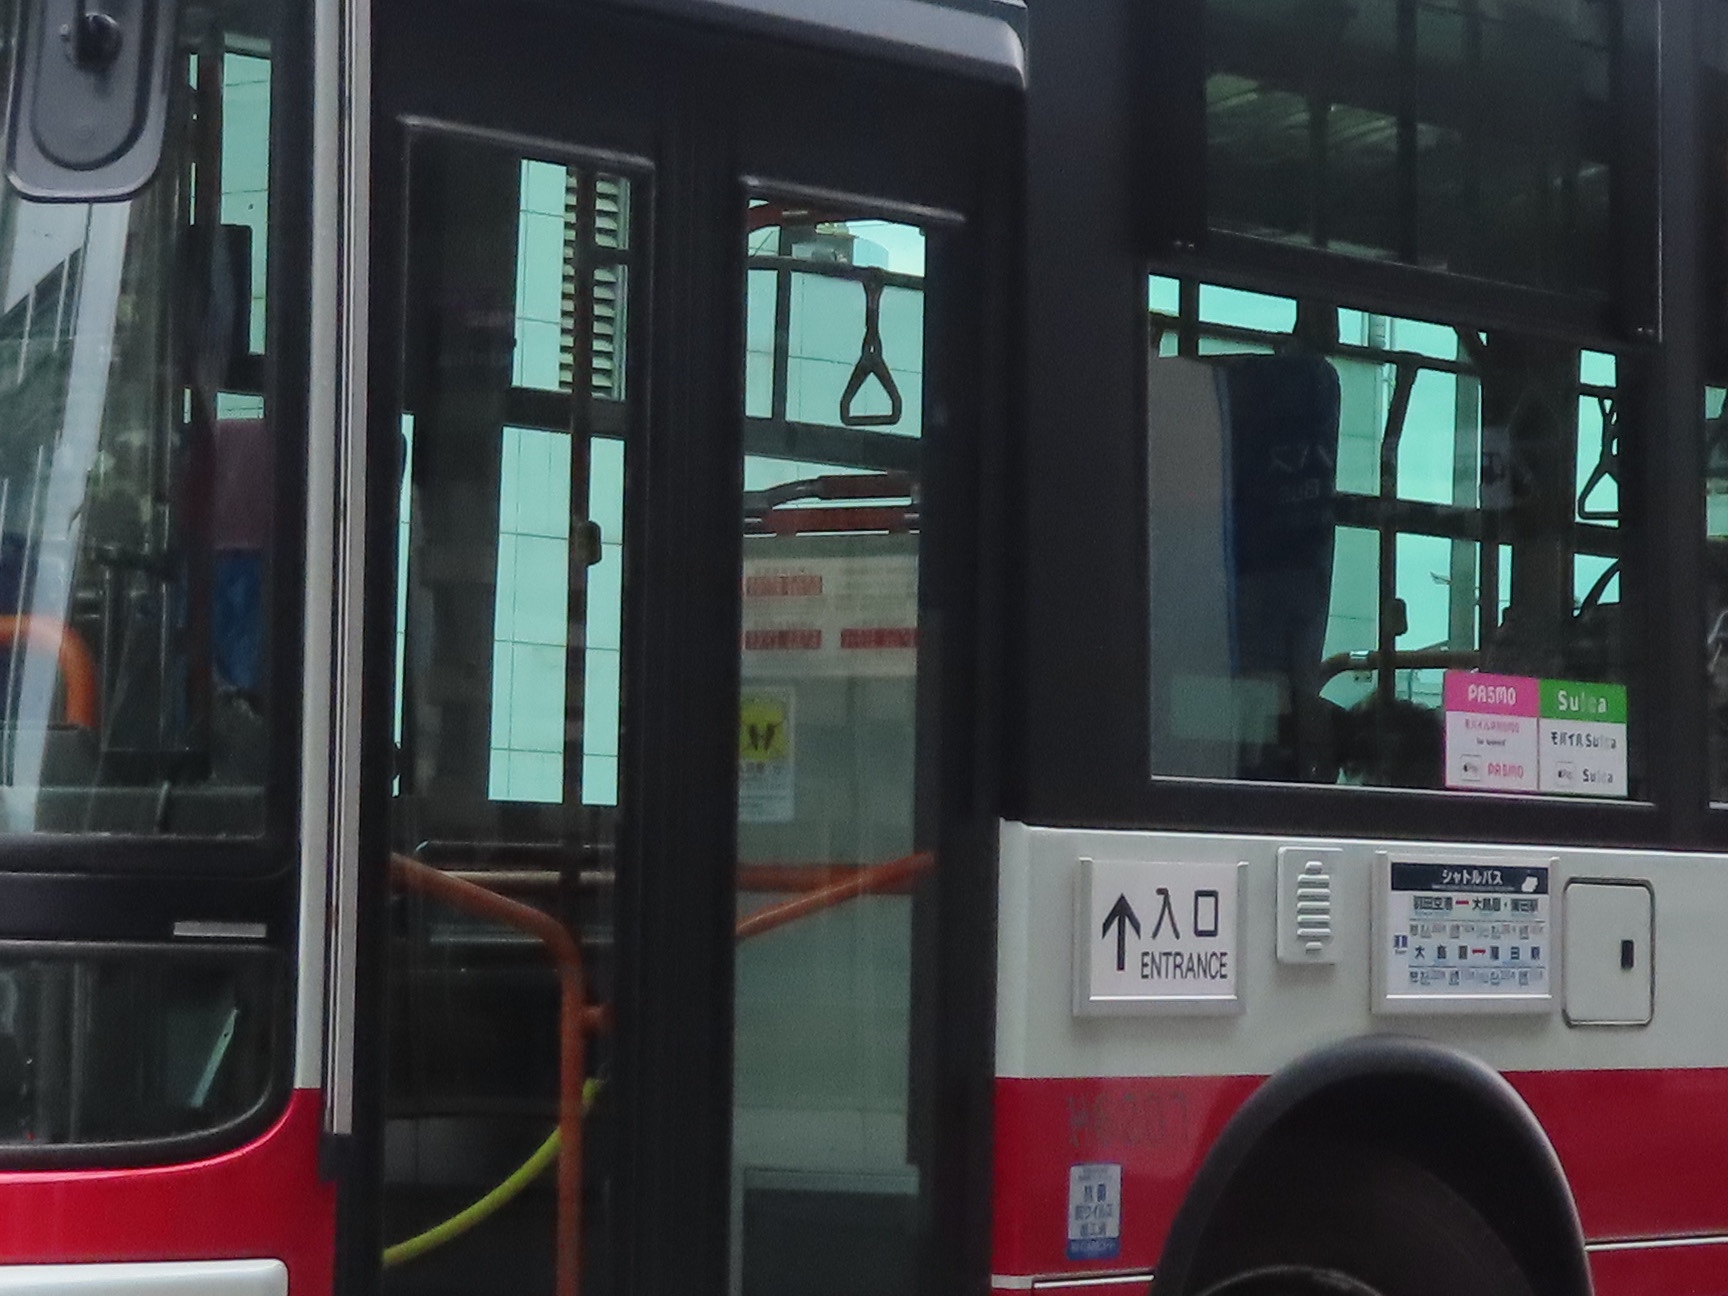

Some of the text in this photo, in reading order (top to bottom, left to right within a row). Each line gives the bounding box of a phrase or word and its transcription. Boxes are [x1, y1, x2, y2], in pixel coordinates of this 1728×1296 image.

[1467, 683, 1517, 706] PASMO
[1487, 761, 1525, 780] PASMO
[1441, 868, 1504, 886] シャトルバス
[1152, 887, 1219, 940] 入口
[1140, 950, 1228, 980] ENTRANCE
